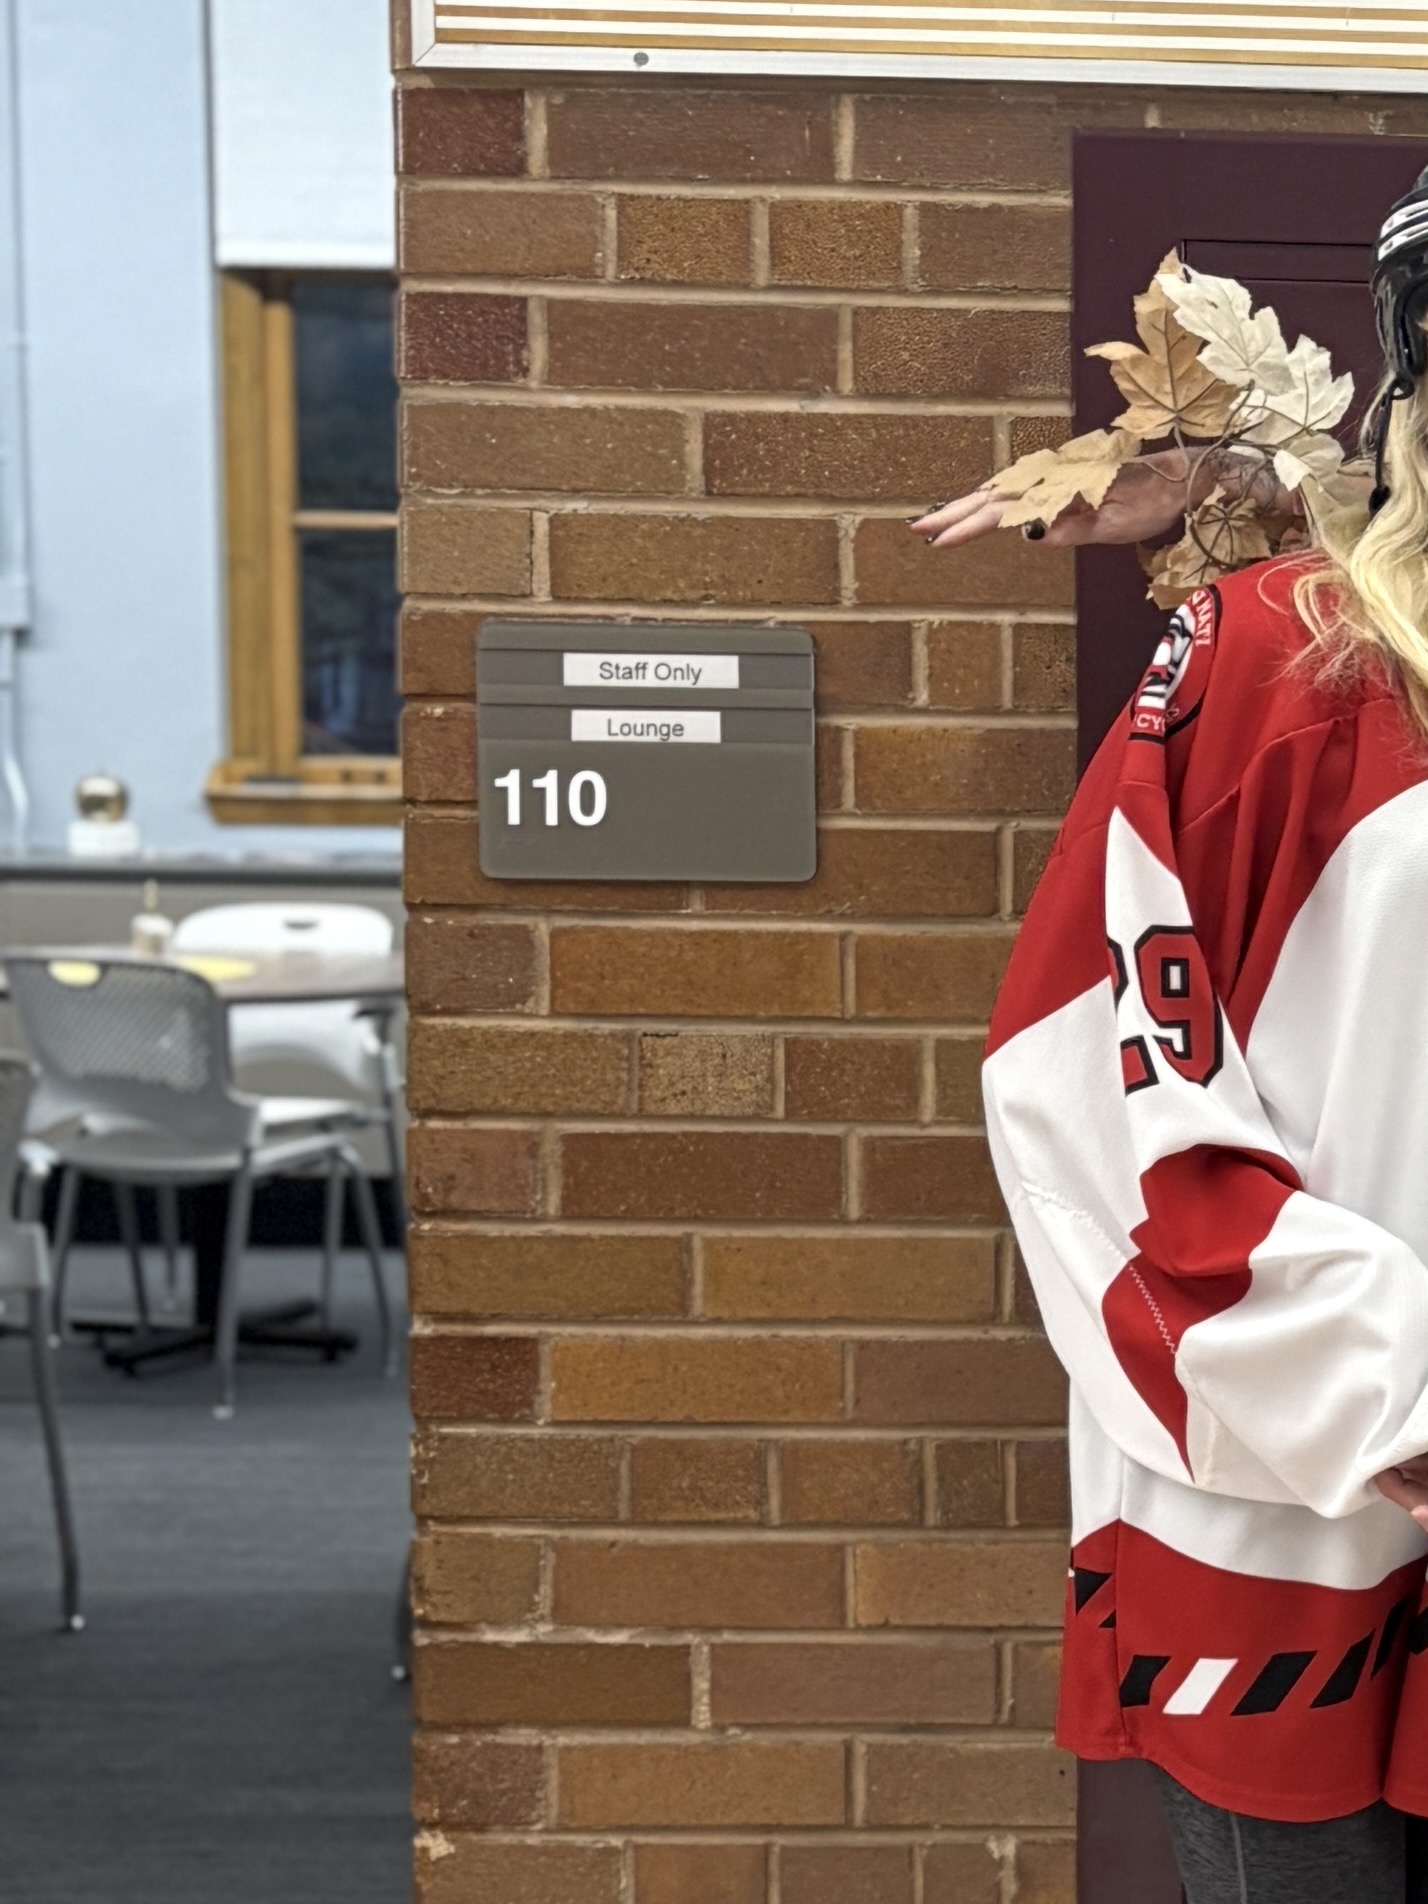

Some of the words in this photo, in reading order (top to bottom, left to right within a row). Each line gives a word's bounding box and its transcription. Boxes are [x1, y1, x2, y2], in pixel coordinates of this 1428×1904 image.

[598, 660, 650, 682] Staff
[653, 662, 703, 686] Only
[606, 717, 686, 742] Lounge
[493, 767, 608, 827] 110
